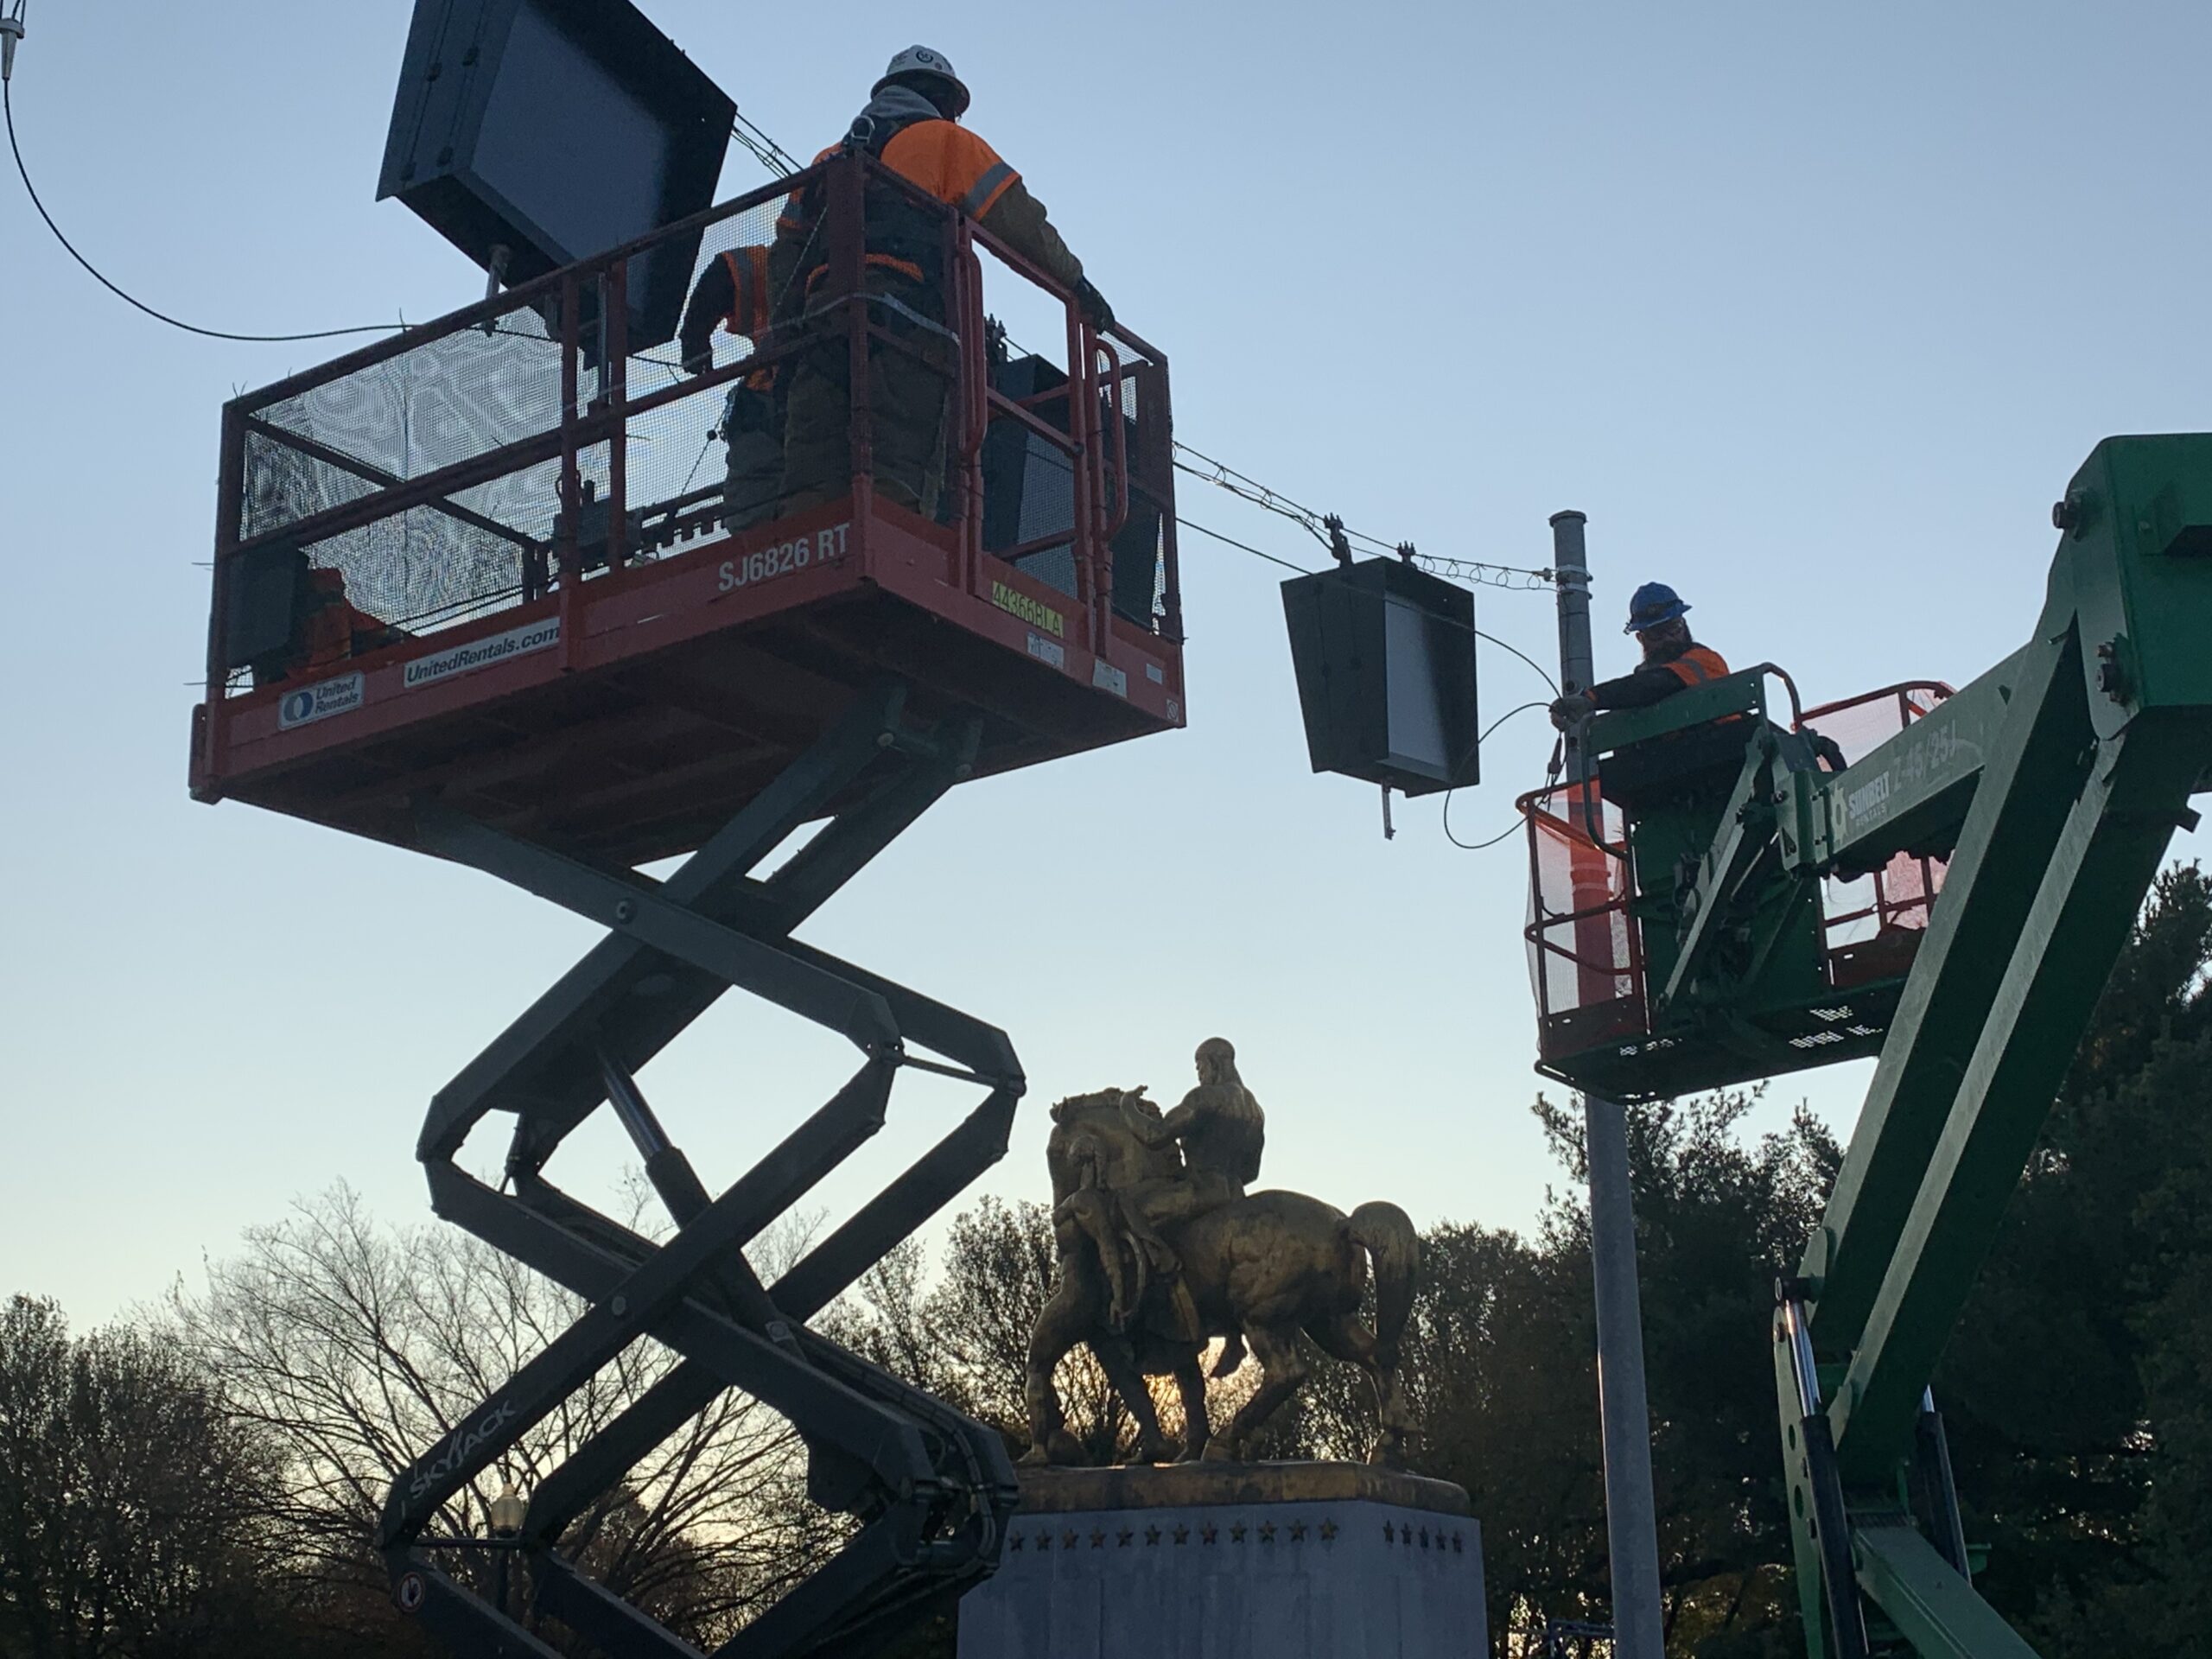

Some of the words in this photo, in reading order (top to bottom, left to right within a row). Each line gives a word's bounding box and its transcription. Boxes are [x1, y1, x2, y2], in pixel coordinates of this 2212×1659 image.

[718, 537, 810, 591] SJ6826
[817, 522, 850, 561] RT
[407, 626, 560, 683] UnitedRentals.com
[315, 691, 359, 714] Rentals
[316, 677, 357, 700] United
[1848, 771, 1890, 820] SUNBELT
[1856, 802, 1887, 827] RENTALS
[410, 1400, 517, 1499] SKYJACK
